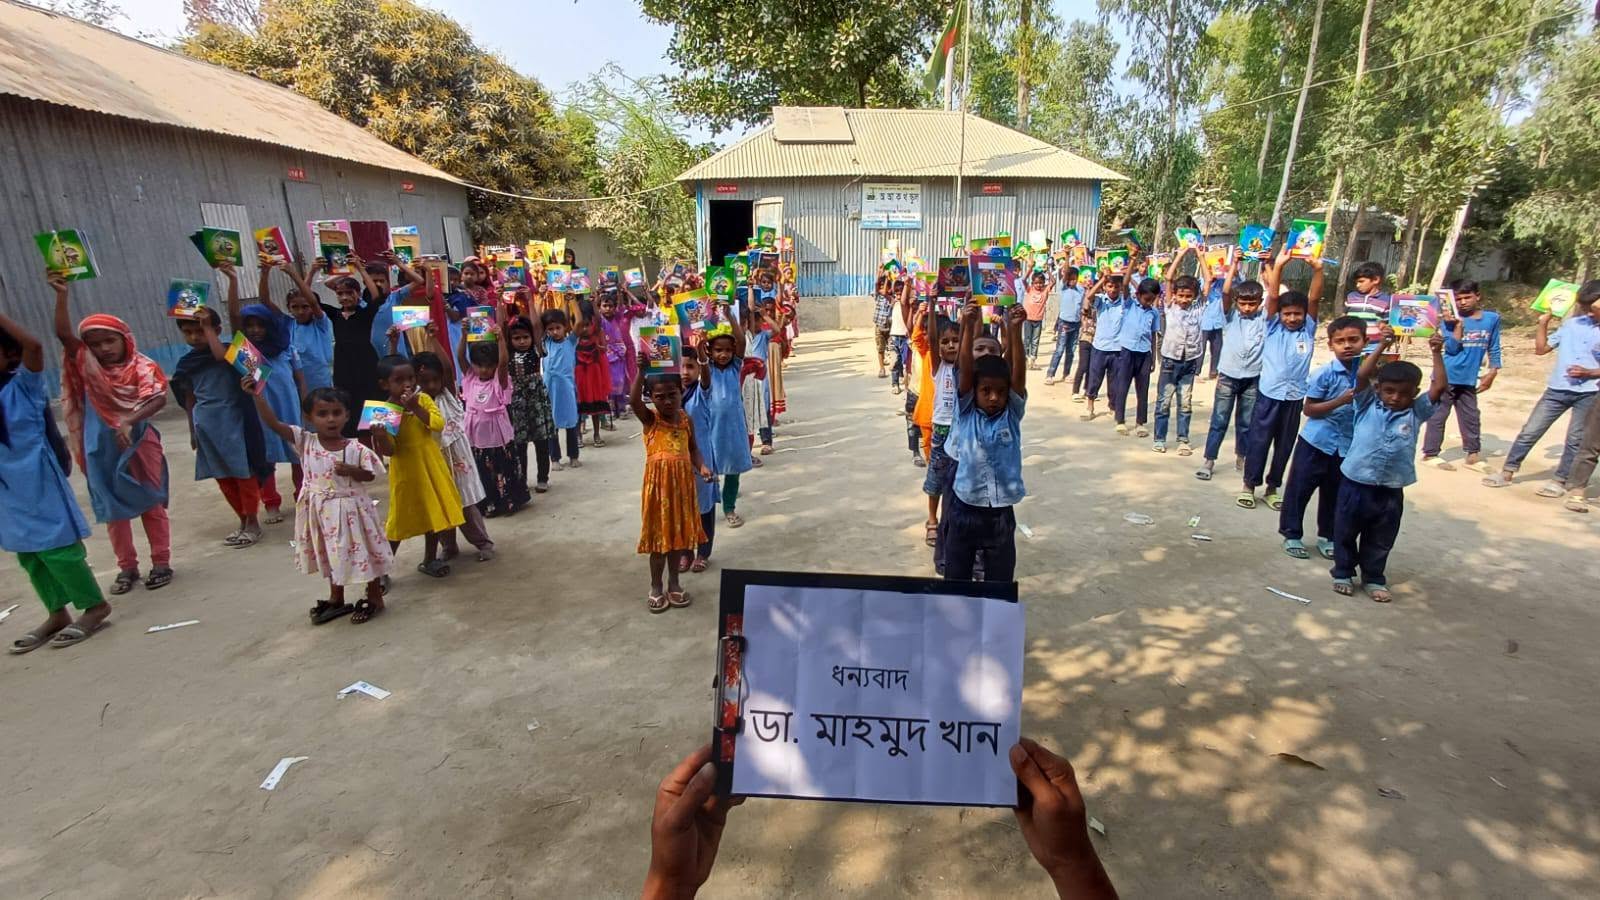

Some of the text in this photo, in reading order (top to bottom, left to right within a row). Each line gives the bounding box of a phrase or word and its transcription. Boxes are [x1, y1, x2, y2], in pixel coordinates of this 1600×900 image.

[832, 665, 909, 690] ধন্যবাদ
[750, 710, 1002, 757] ডা. মাহমুদ খান
